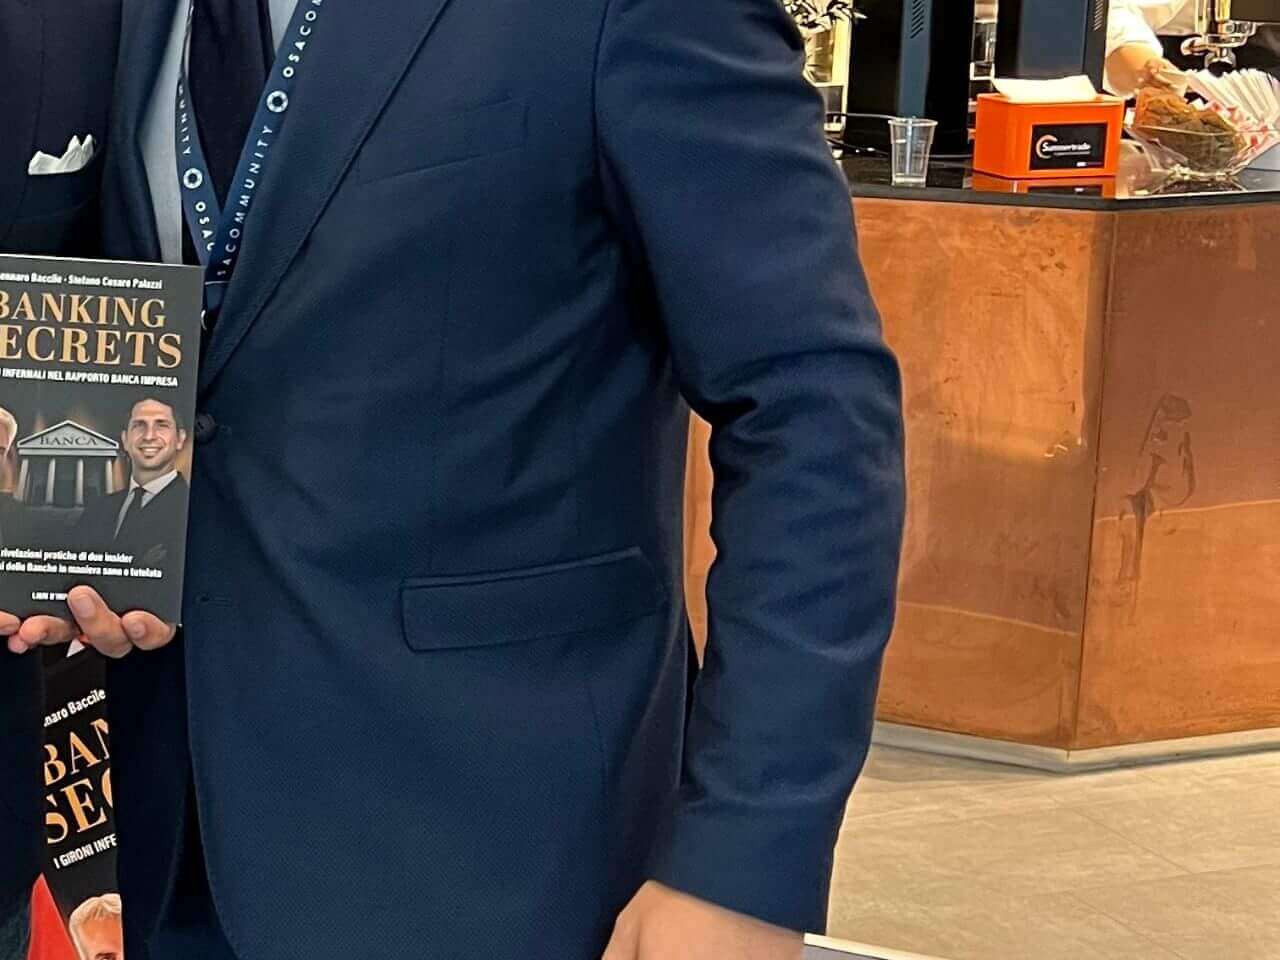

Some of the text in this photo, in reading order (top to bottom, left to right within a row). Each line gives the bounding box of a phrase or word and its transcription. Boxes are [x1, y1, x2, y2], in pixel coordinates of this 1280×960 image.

[2, 367, 47, 380] INFERNALI
[48, 370, 64, 381] NEL
[65, 371, 110, 383] RAPPORTO
[111, 374, 140, 385] BANCA
[140, 375, 178, 387] IMPRESA
[43, 688, 106, 727] naro Baccile
[53, 857, 61, 869] I
[60, 844, 94, 867] GIRONI
